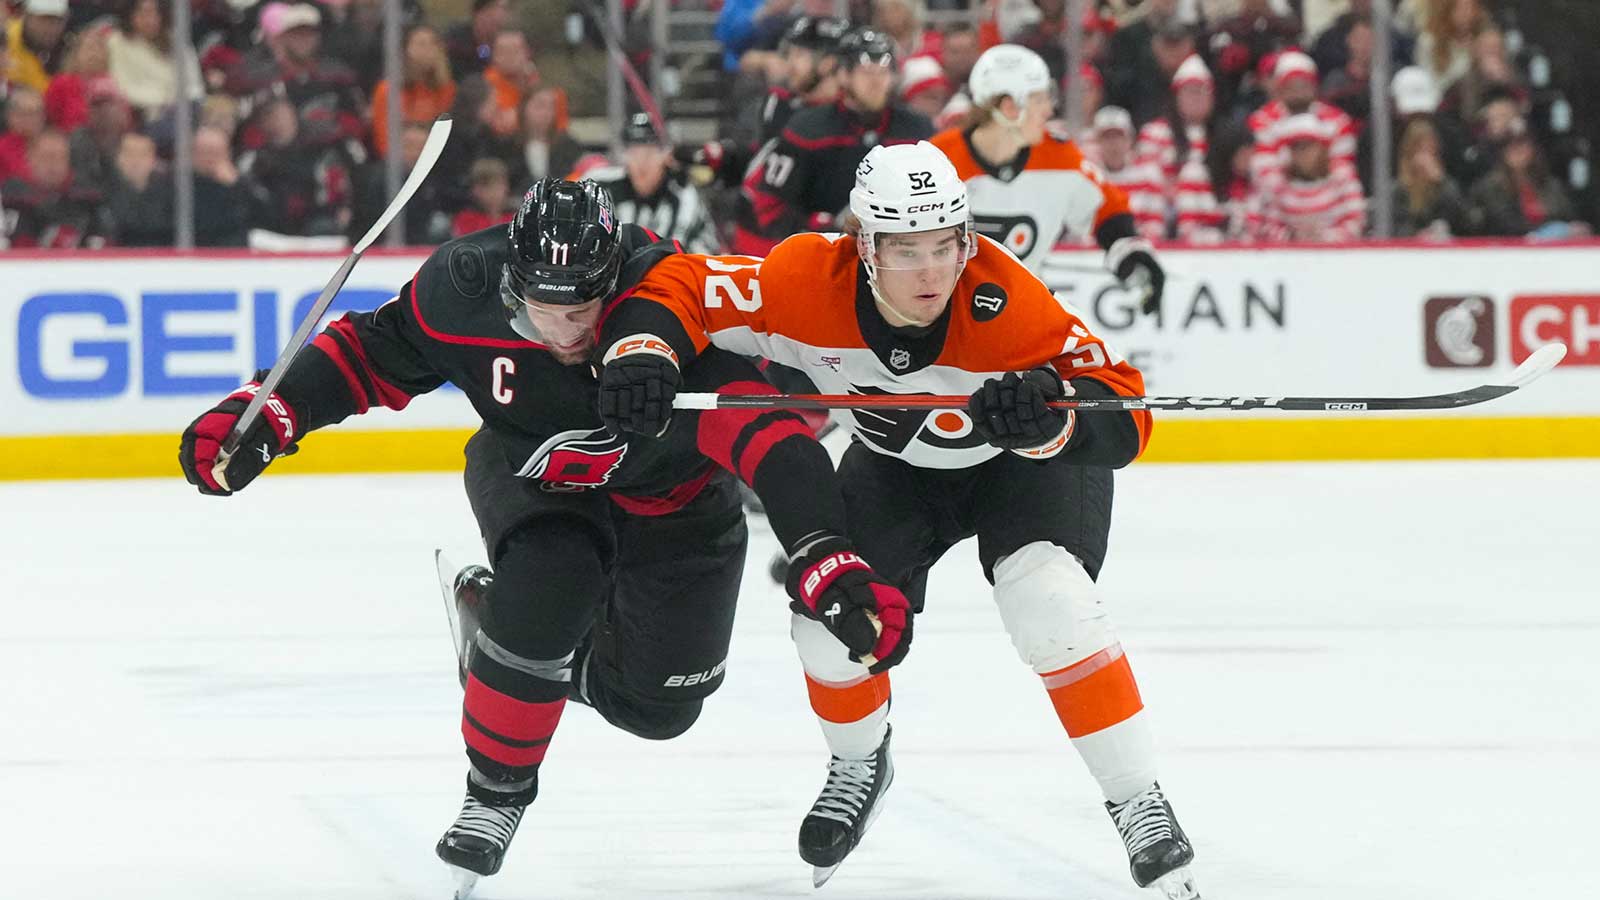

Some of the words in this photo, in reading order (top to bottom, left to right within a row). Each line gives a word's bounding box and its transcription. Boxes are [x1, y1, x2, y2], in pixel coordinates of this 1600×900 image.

[908, 171, 937, 191] 52
[907, 202, 945, 214] CCM
[551, 243, 569, 266] 11
[537, 283, 577, 293] BAUER
[974, 294, 1003, 312] 1
[17, 289, 402, 400] GEI
[492, 356, 516, 405] C
[804, 553, 871, 598] BAU
[663, 659, 727, 688] BAUE
